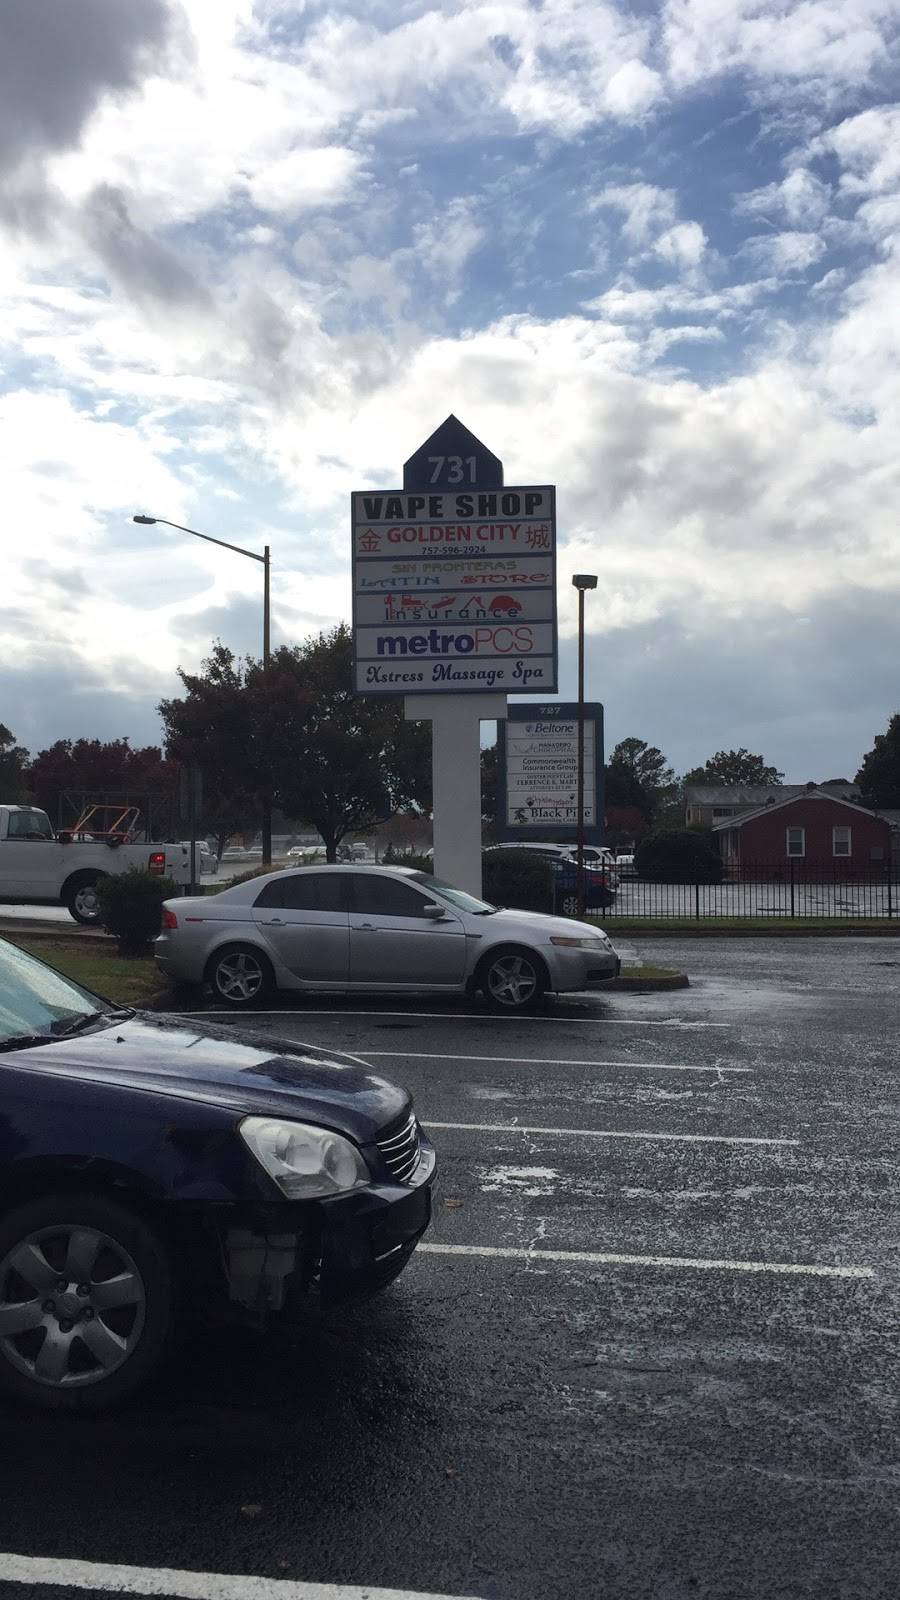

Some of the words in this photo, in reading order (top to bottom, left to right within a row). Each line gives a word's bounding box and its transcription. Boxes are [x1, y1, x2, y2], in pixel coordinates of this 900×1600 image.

[428, 456, 477, 484] 731
[363, 496, 445, 519] VAPE
[455, 493, 543, 517] SHOP
[358, 528, 382, 552] 金
[387, 526, 471, 543] GOLDEN
[476, 524, 521, 541] CITY
[525, 524, 551, 549] 城
[421, 545, 486, 555] 757-596-2924
[391, 563, 416, 574] SIN
[423, 560, 518, 573] FRONTERAS
[377, 627, 534, 655] metroPCS
[366, 665, 424, 684] Xstress
[432, 663, 504, 686] Massage
[512, 660, 544, 685] Spa
[540, 707, 561, 715] 727
[534, 722, 574, 733] Beltone
[557, 764, 578, 772] Group
[531, 807, 562, 818] Black
[566, 807, 592, 818] Pie
